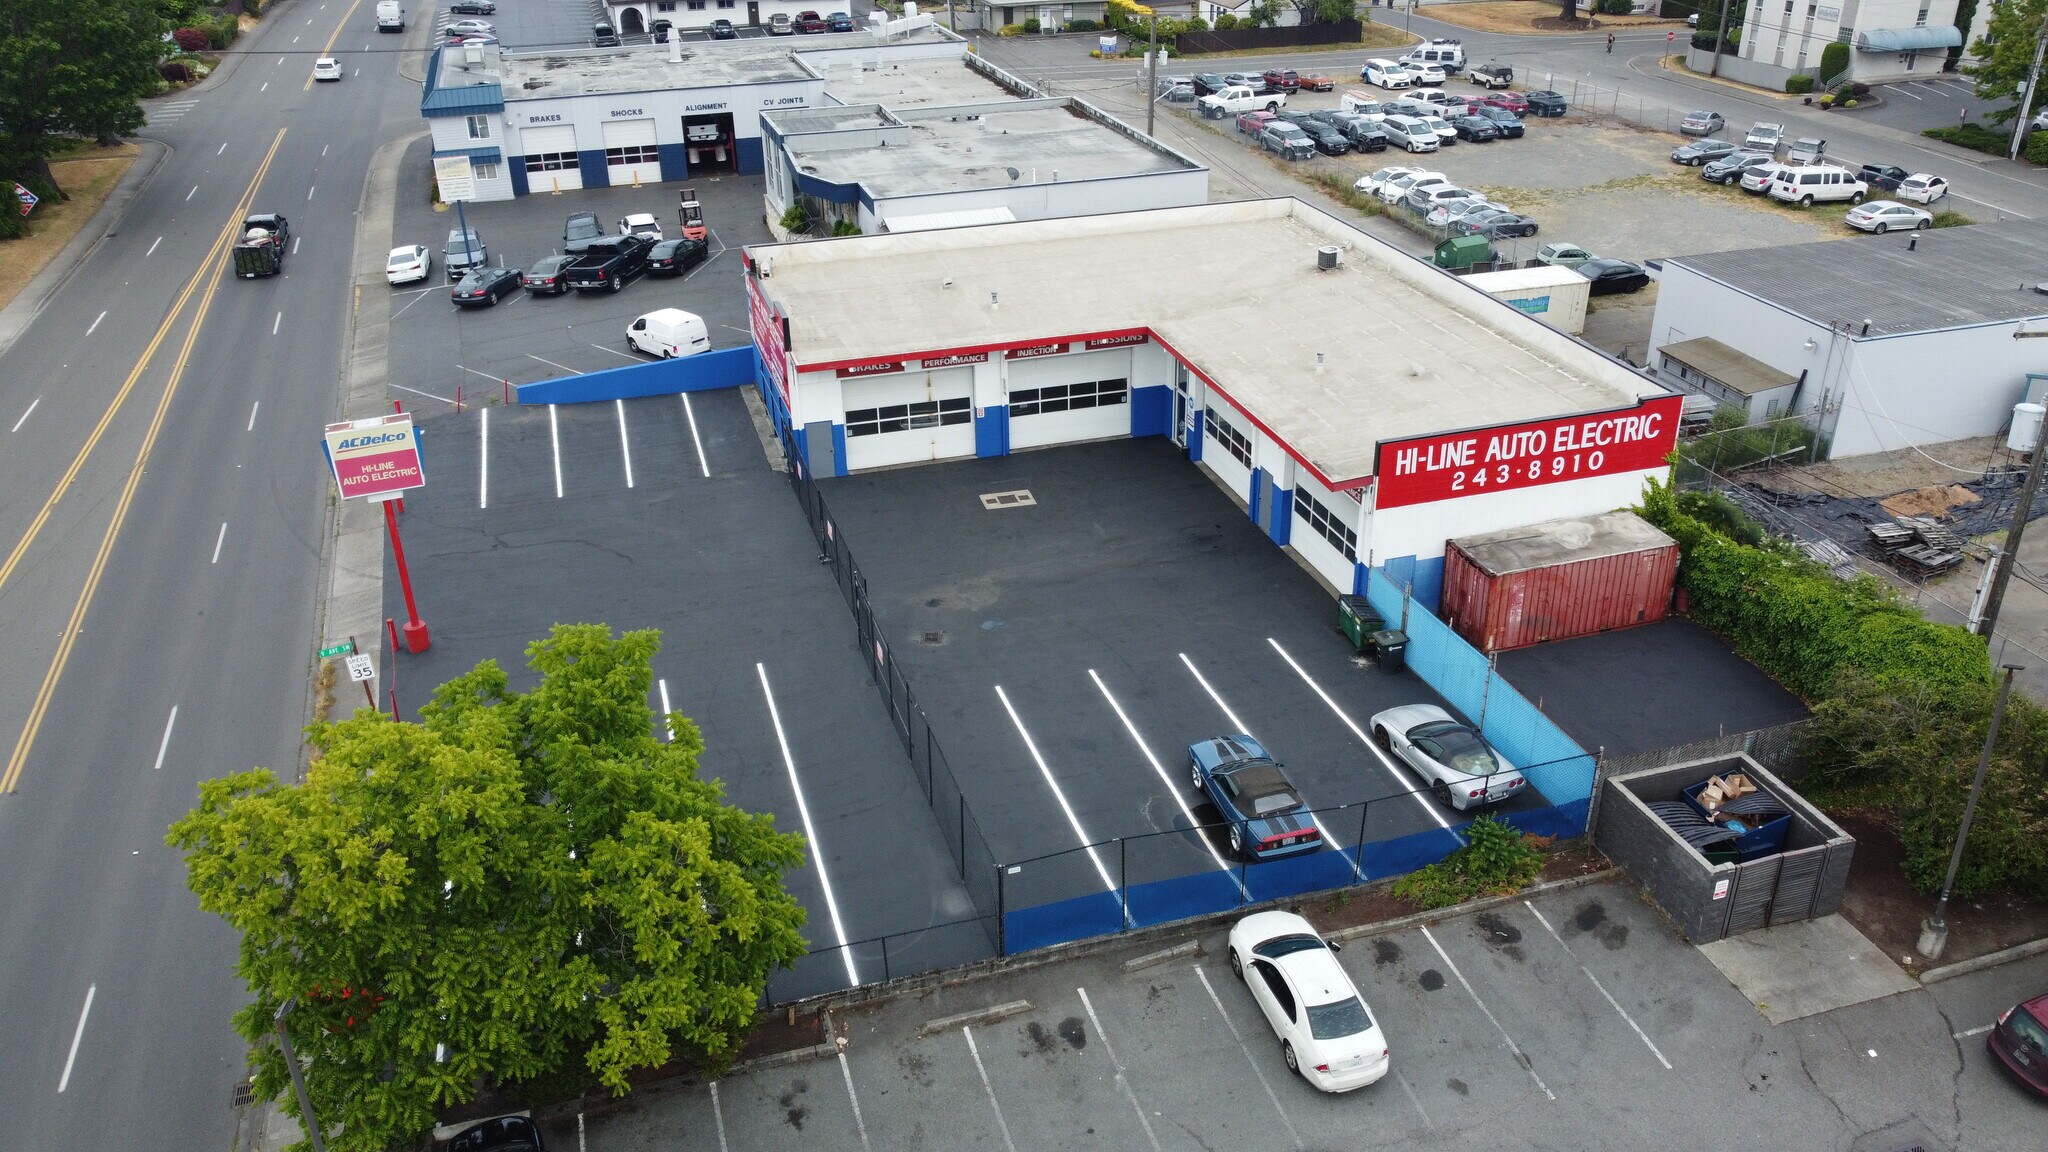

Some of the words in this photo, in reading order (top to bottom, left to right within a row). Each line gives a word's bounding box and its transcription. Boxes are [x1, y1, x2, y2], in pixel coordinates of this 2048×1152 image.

[777, 97, 804, 105] JOINTS
[610, 108, 643, 117] SHOCKS
[685, 102, 728, 112] ALIGNMENT
[529, 114, 562, 123] BRAKES
[1017, 346, 1057, 357] INJECTION
[924, 354, 986, 367] PERFORMANCE
[337, 432, 406, 450] ACDelco
[1395, 438, 1477, 476] HI-LINE
[1485, 429, 1547, 463] AUTO
[1552, 413, 1662, 453] ELECTRIC
[361, 461, 395, 474] HI-LINE
[343, 474, 370, 486] AUTO
[371, 467, 418, 482] ELECTRIC
[328, 647, 339, 655] AVE
[348, 656, 369, 665] SPEED
[353, 666, 373, 679] 35
